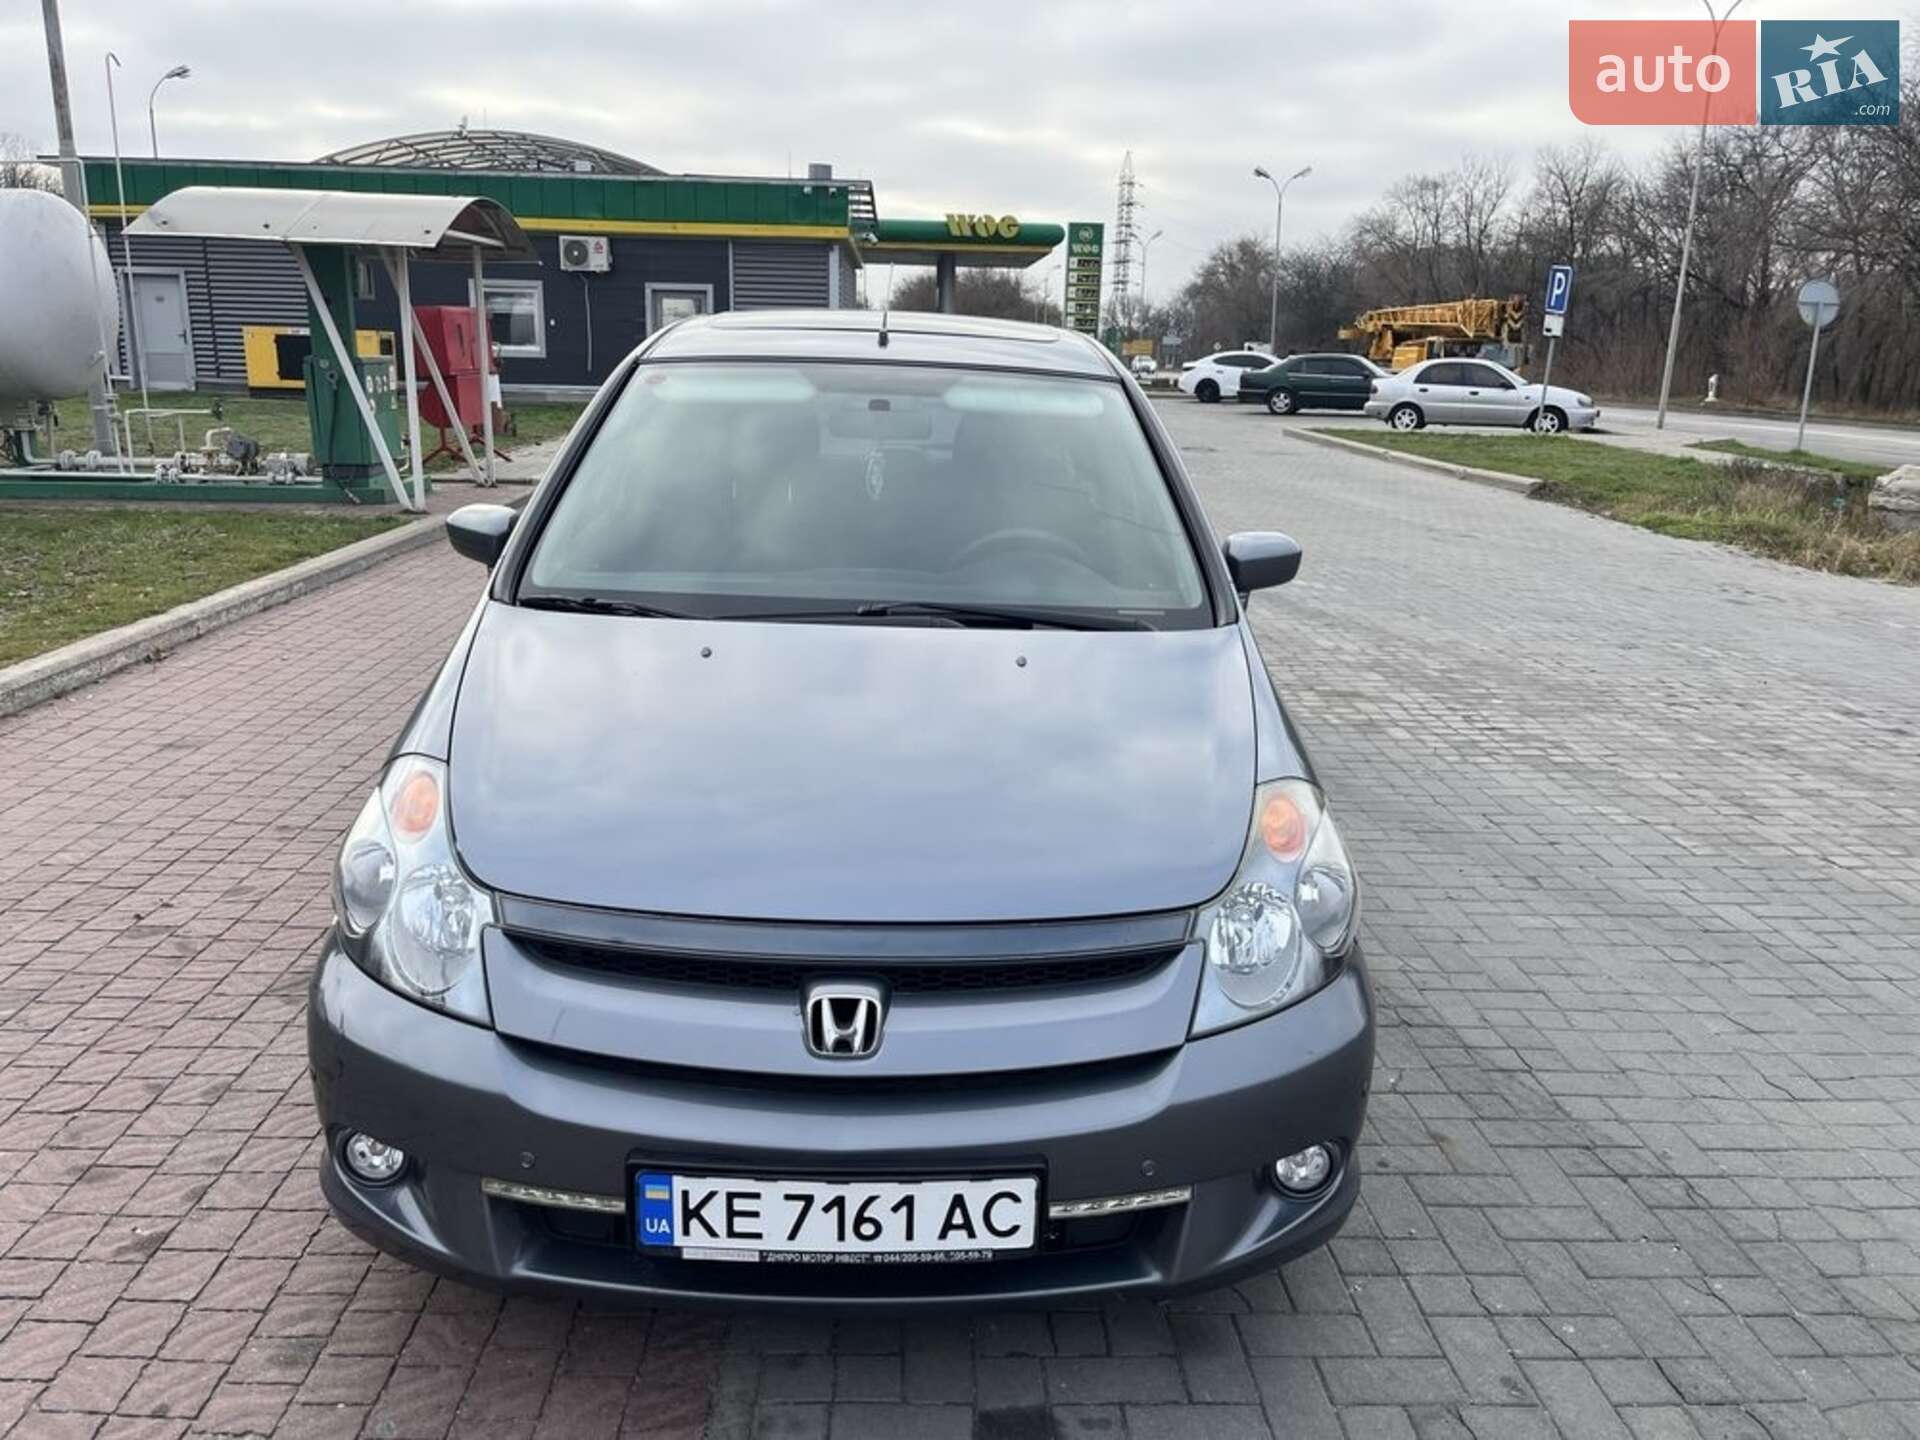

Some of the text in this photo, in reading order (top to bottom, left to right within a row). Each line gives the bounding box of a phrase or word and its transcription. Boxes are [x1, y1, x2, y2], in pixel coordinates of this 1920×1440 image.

[1551, 272, 1566, 307] P
[646, 1218, 671, 1234] UA
[681, 1189, 1022, 1242] KE 7161 AC
